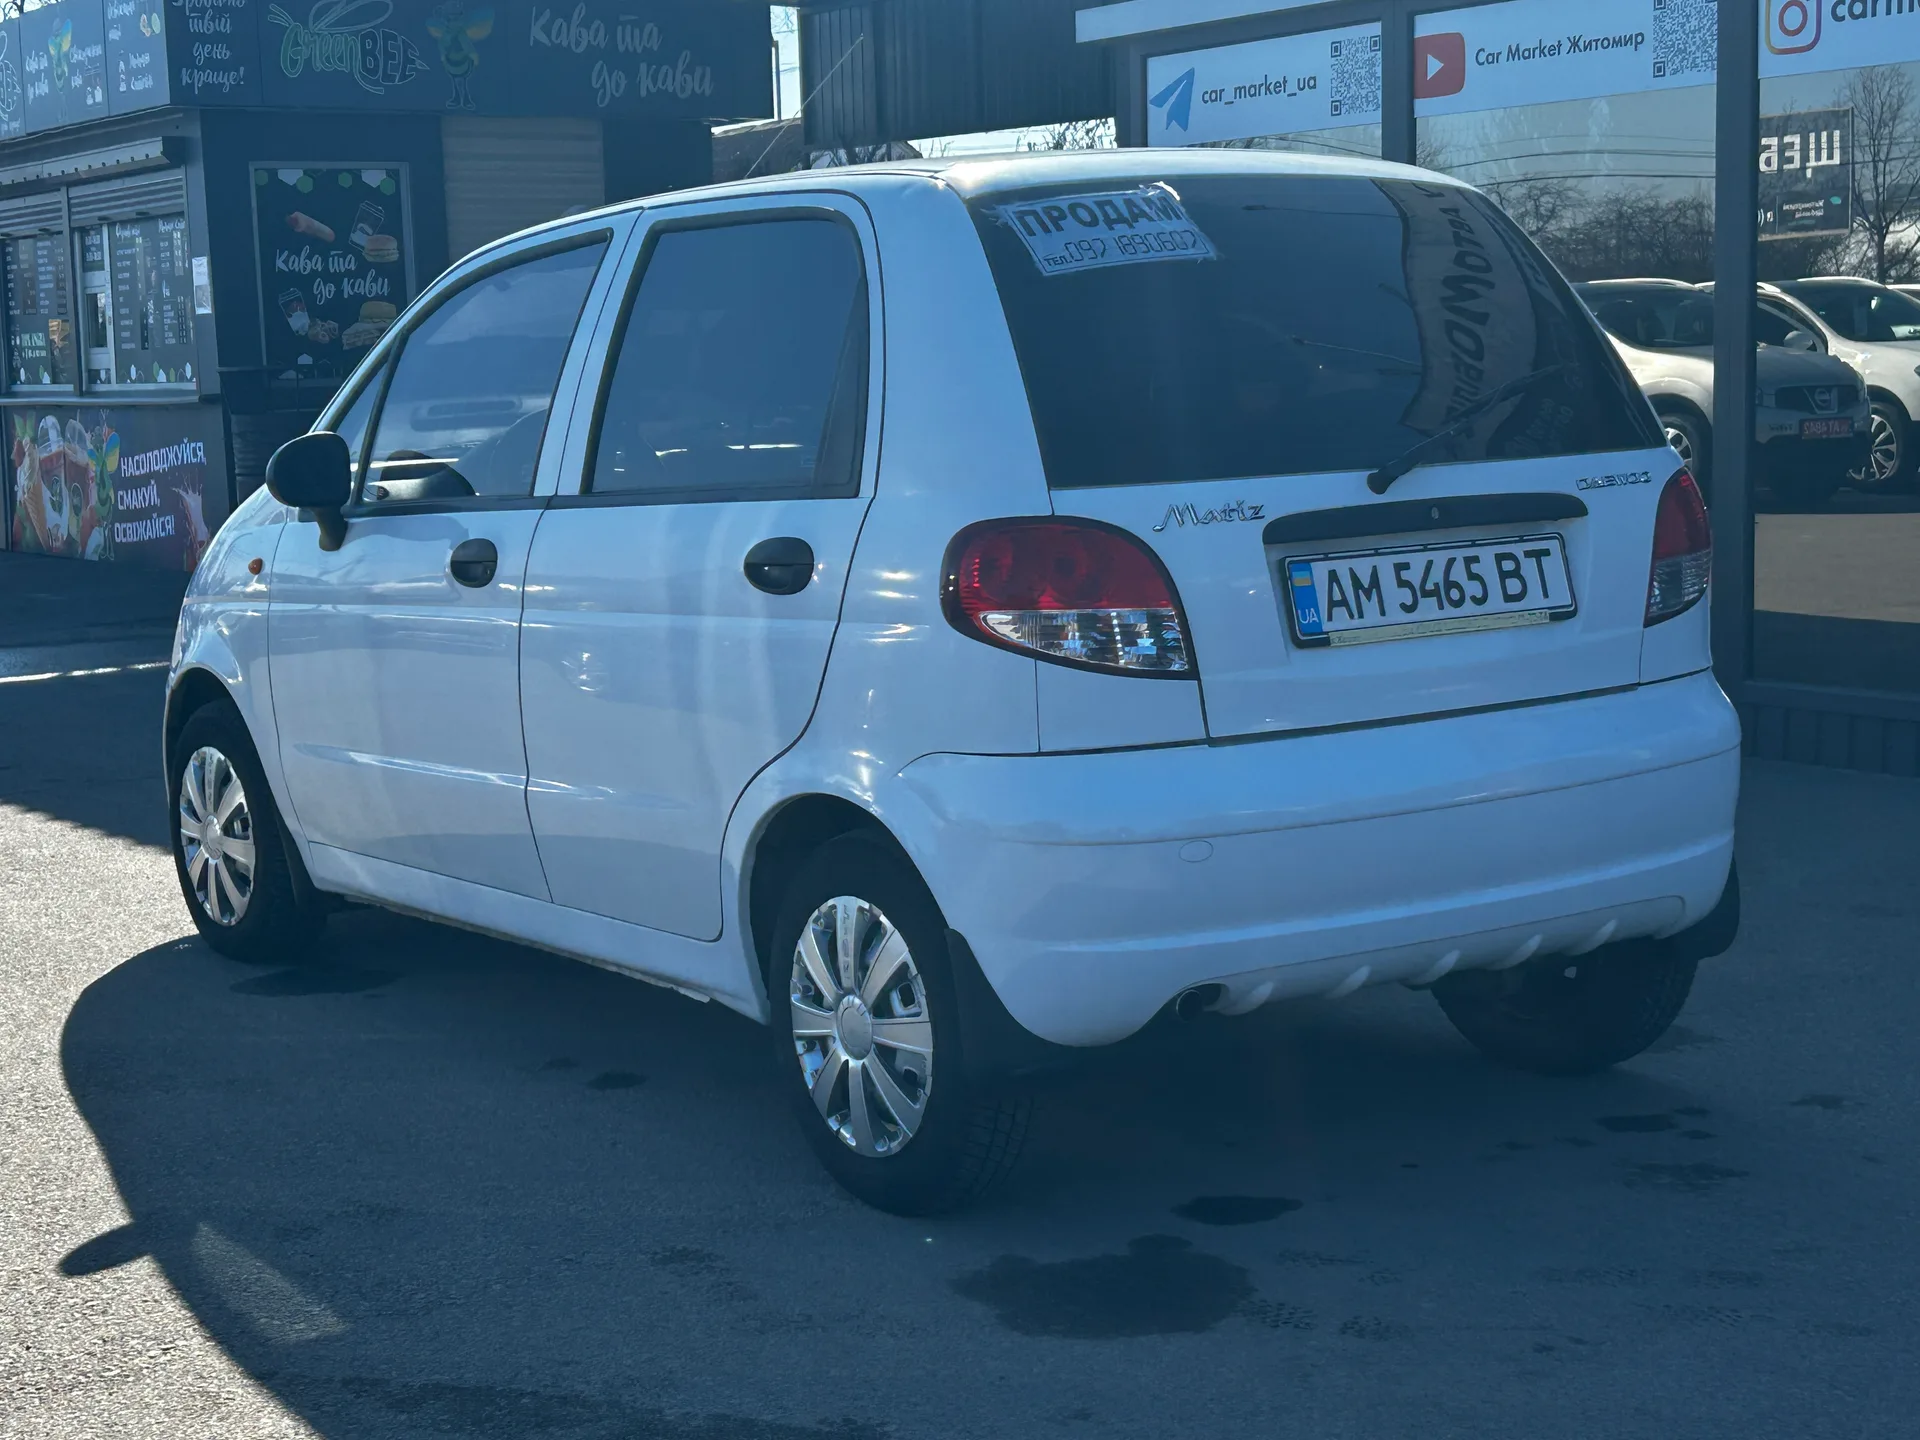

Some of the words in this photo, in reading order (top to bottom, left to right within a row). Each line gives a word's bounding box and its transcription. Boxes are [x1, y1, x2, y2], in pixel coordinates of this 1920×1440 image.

[188, 9, 232, 34] твій
[529, 1, 608, 53] Кава
[616, 14, 663, 53] та
[1830, 0, 1920, 22] carm
[192, 41, 231, 66] день
[1475, 46, 1502, 66] Car
[1506, 38, 1563, 63] Market
[1566, 30, 1646, 56] Житомир
[180, 66, 245, 94] краще!
[591, 60, 627, 107] до
[636, 49, 714, 98] кави
[1201, 74, 1317, 106] car_market_ua
[1012, 195, 1183, 236] ПРОДАМ
[275, 248, 324, 275] Кава
[328, 250, 358, 273] та
[1064, 238, 1107, 262] 097
[1113, 230, 1197, 256] 1890607
[312, 279, 336, 304] до
[342, 266, 391, 296] кави
[120, 437, 207, 478] НАСОЛОДЖУЙСЯ,
[117, 478, 161, 511] СМАКУЙ,
[114, 512, 176, 543] ОСВІЖАЙСЯ!
[1152, 499, 1266, 532] Matiz
[1326, 564, 1386, 622] AM
[1393, 555, 1489, 614] 5465
[1494, 548, 1552, 604] BT
[1298, 607, 1319, 625] UA
